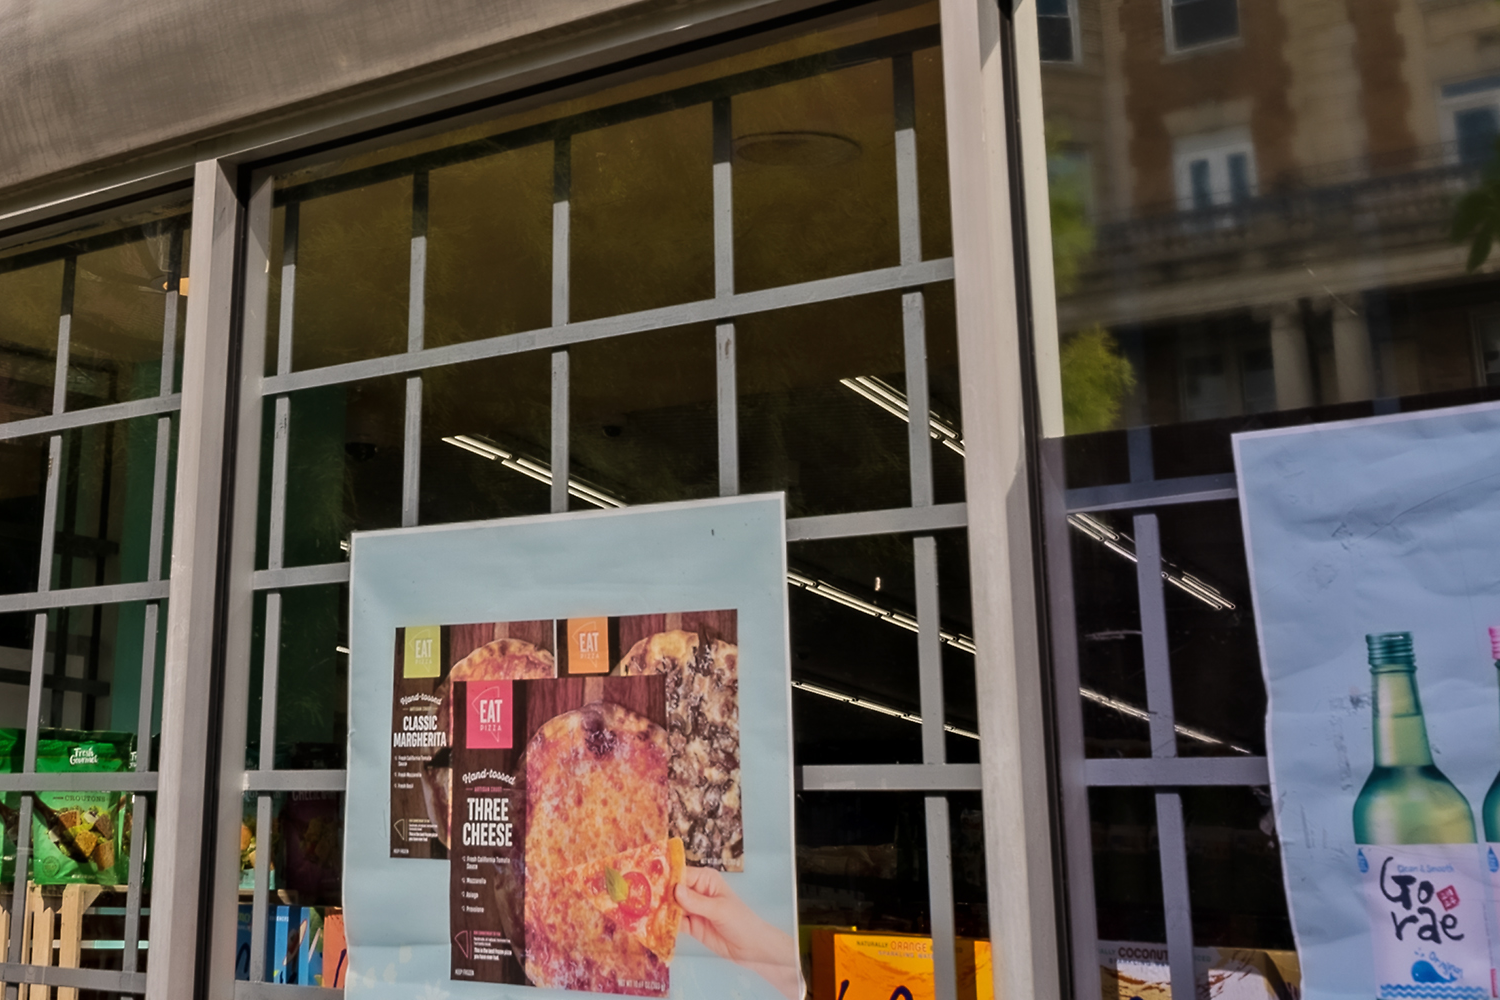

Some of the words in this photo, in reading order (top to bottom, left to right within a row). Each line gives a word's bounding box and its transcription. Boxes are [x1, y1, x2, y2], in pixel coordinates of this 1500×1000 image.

[415, 639, 433, 659] EAT
[579, 632, 599, 653] EAT
[479, 699, 503, 724] EAT
[403, 715, 438, 731] CLASSIC
[393, 731, 447, 748] MARGHERITA
[74, 746, 94, 757] Fresh
[462, 768, 516, 786] Hand-tossed
[64, 794, 106, 802] CROUTONS
[467, 797, 509, 821] THREE
[462, 822, 513, 847] CHEESE
[1391, 907, 1464, 944] rae
[856, 940, 888, 948] NATURALLY
[890, 941, 927, 952] ORANGE
[877, 950, 914, 958] SPARKLING
[1118, 947, 1168, 960] COCONUT
